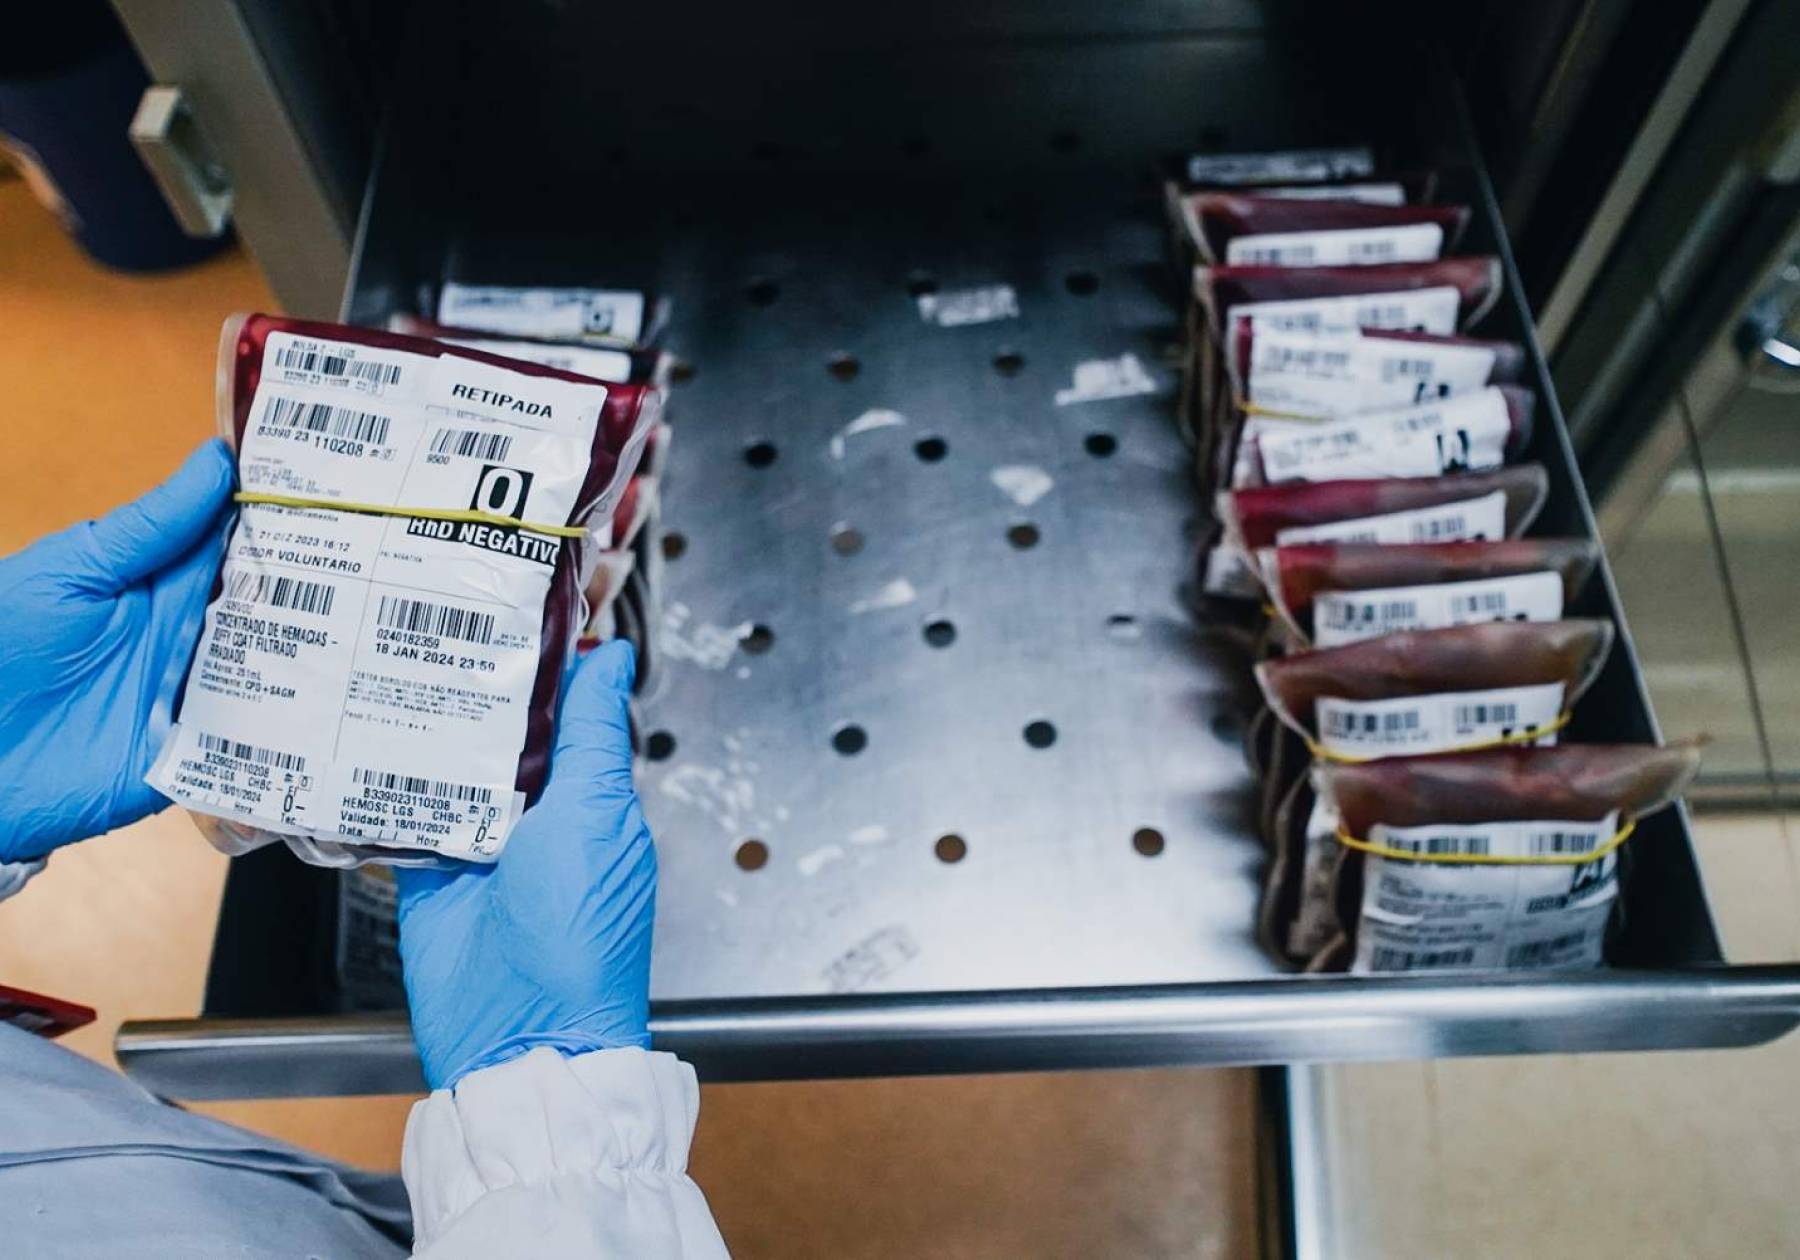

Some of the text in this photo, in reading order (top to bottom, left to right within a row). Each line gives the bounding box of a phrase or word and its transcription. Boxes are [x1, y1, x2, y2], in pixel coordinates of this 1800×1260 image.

[452, 383, 553, 419] RETIPADA
[294, 429, 309, 442] 23
[315, 436, 364, 458] 110208
[426, 453, 450, 466] 9500
[294, 535, 319, 547] 2023
[278, 551, 362, 574] VOLUNTARIO
[232, 631, 255, 649] COAT
[256, 635, 298, 659] FILTRADO
[267, 622, 280, 637] DE
[281, 624, 328, 648] HEMACIAS
[376, 627, 442, 650] 0240182359
[375, 642, 389, 655] 18
[393, 644, 419, 661] JAN
[422, 650, 455, 667] 2024
[269, 685, 296, 699] SAGM
[179, 759, 218, 778] HEMOSC
[219, 770, 236, 783] LGS
[248, 776, 273, 792] CHBC
[204, 751, 271, 778] B339023110208
[342, 796, 389, 814] HEMOSC
[392, 805, 414, 818] LGS
[432, 811, 463, 824] CHBC
[363, 787, 451, 811] B339023110208
[395, 818, 451, 836] 18/01/2024
